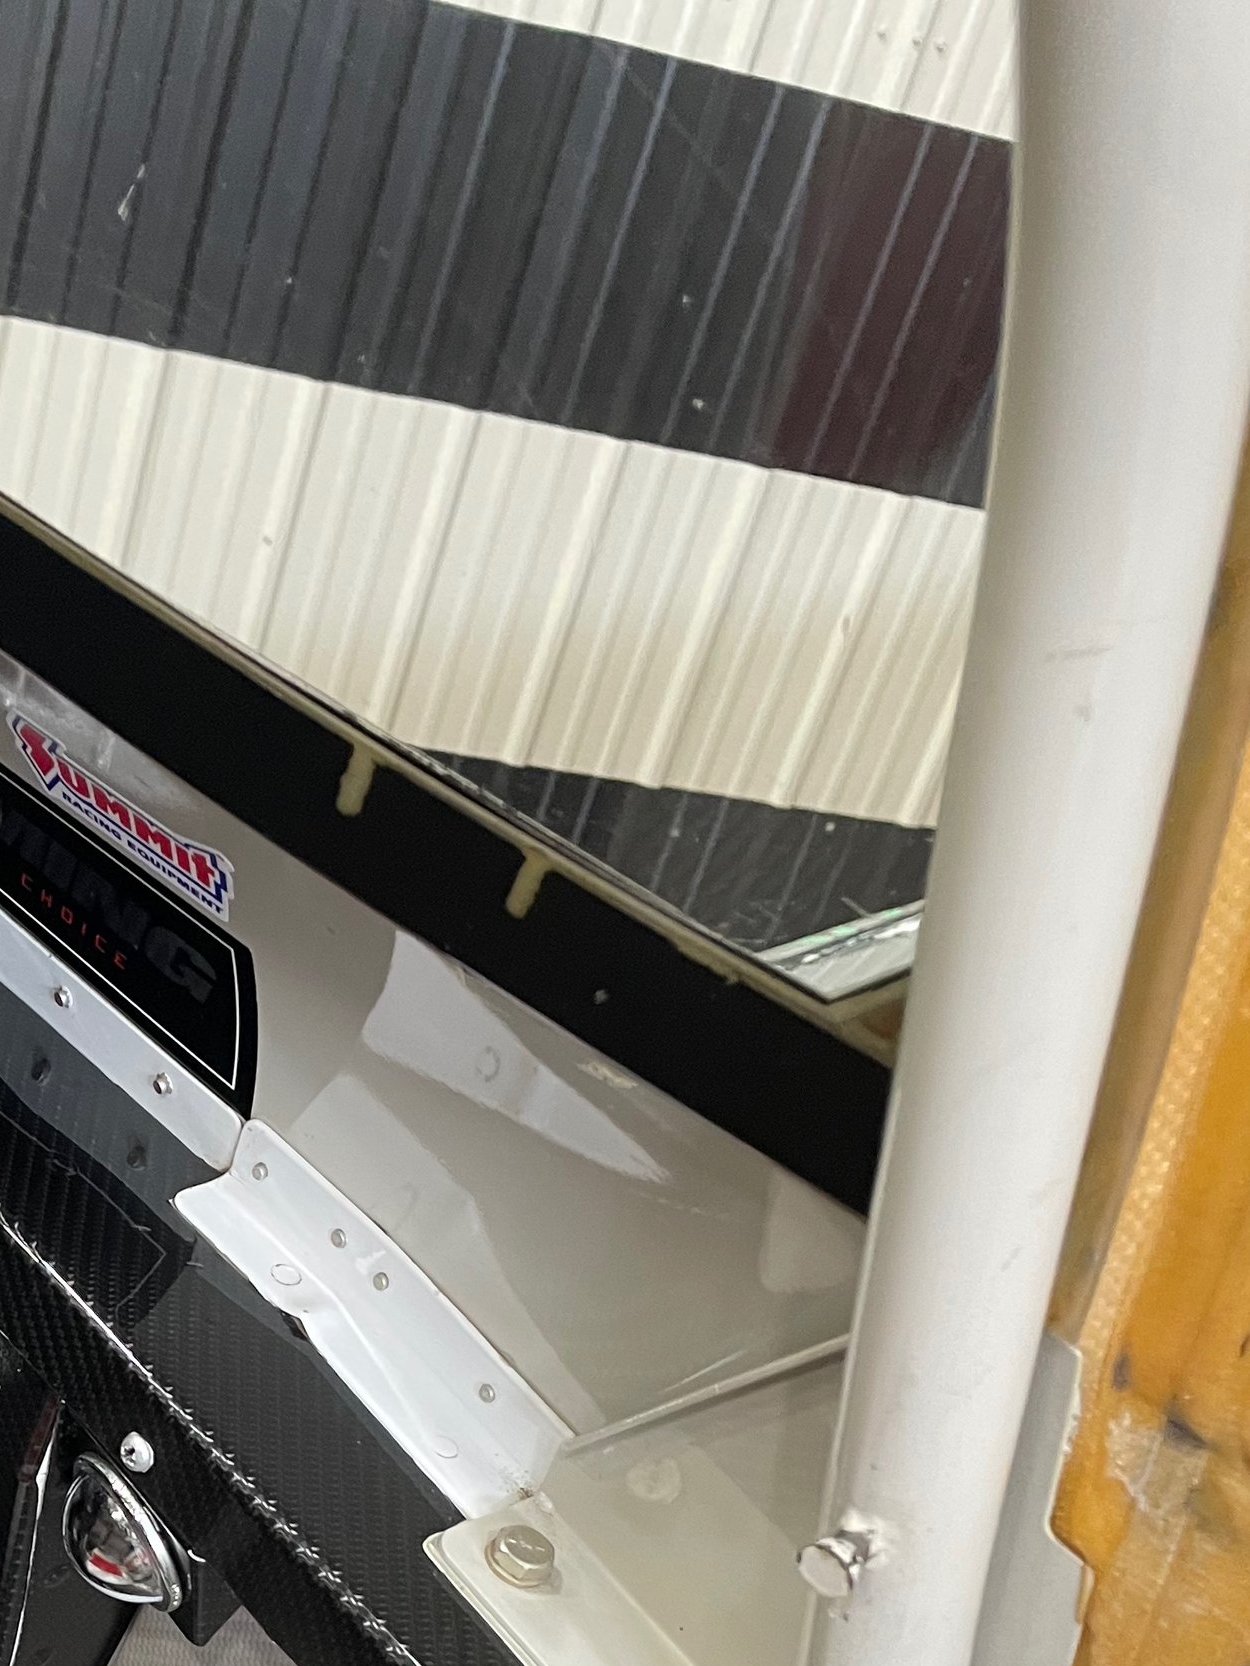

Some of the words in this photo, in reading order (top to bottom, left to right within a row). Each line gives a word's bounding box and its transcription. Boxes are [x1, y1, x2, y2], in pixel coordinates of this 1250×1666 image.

[61, 790, 122, 841] RACING
[126, 838, 224, 915] EQUIPMENT
[20, 873, 129, 971] CHOICE
